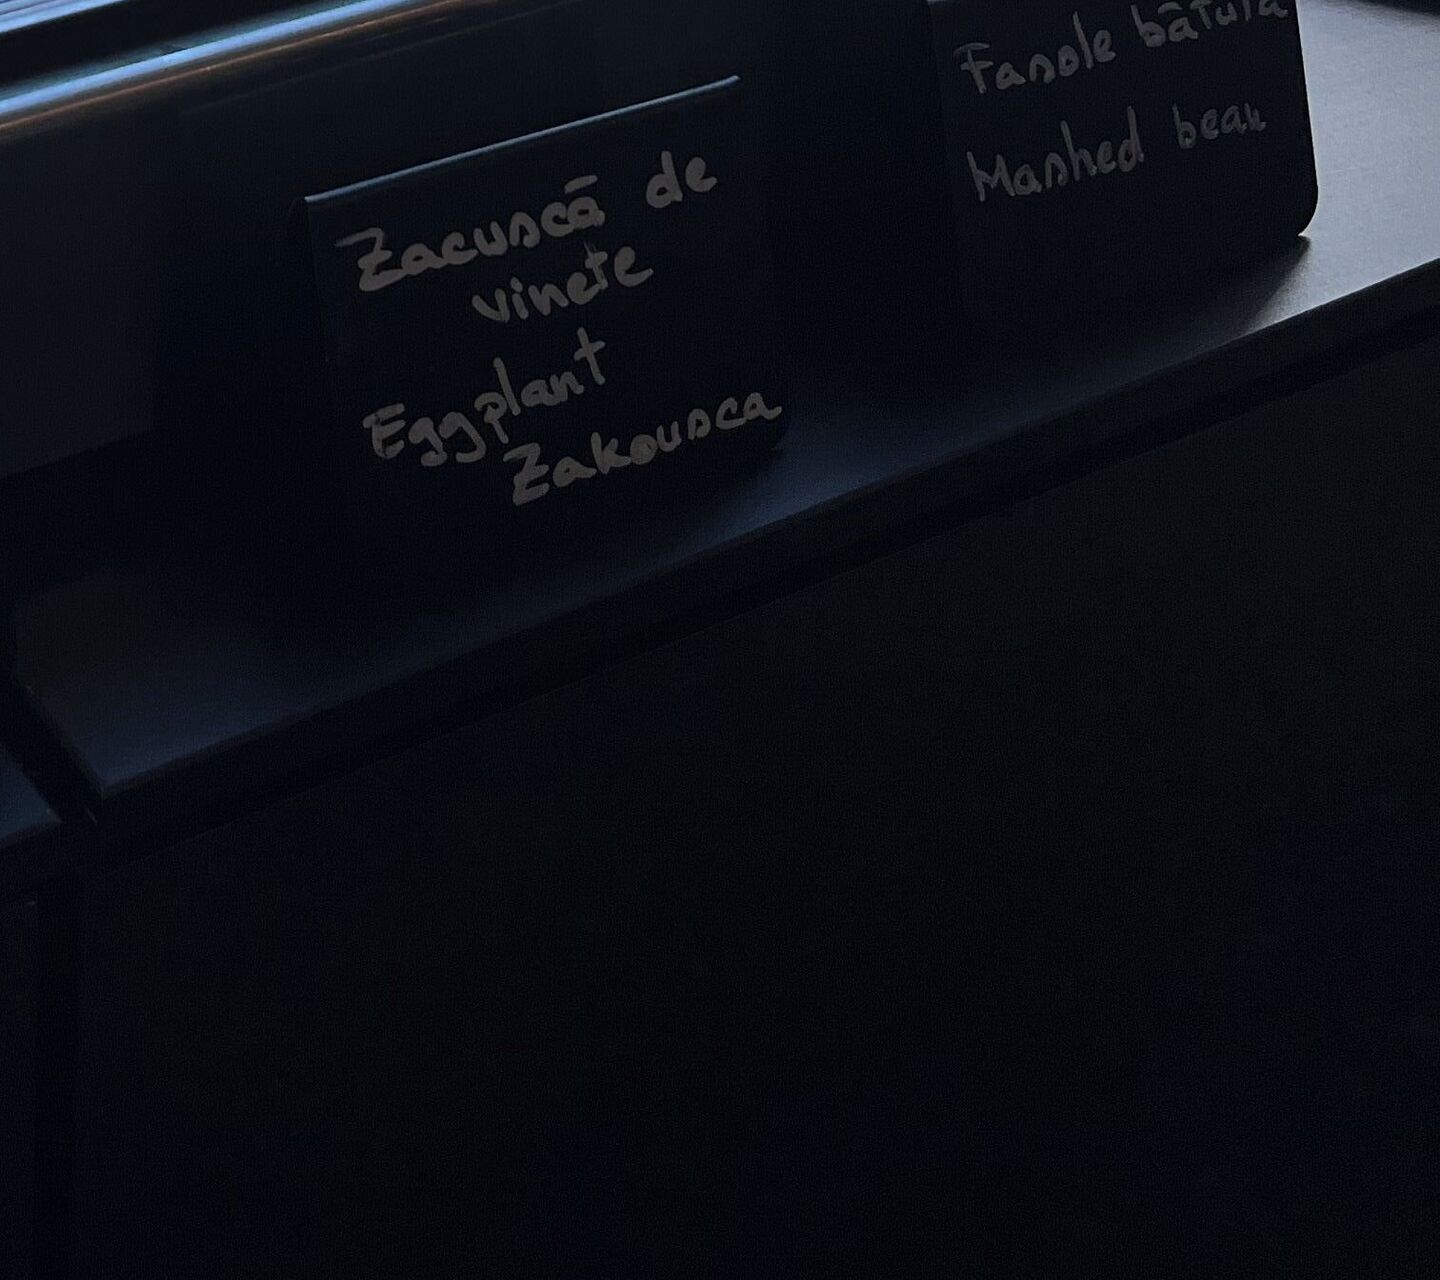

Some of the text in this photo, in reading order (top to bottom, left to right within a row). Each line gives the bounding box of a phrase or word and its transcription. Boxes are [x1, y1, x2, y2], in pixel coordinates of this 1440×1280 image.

[1173, 102, 1267, 150] bean
[645, 150, 719, 209] de
[471, 241, 655, 323] vinete
[362, 327, 607, 467] Eggplant
[503, 392, 783, 506] Zakousca
